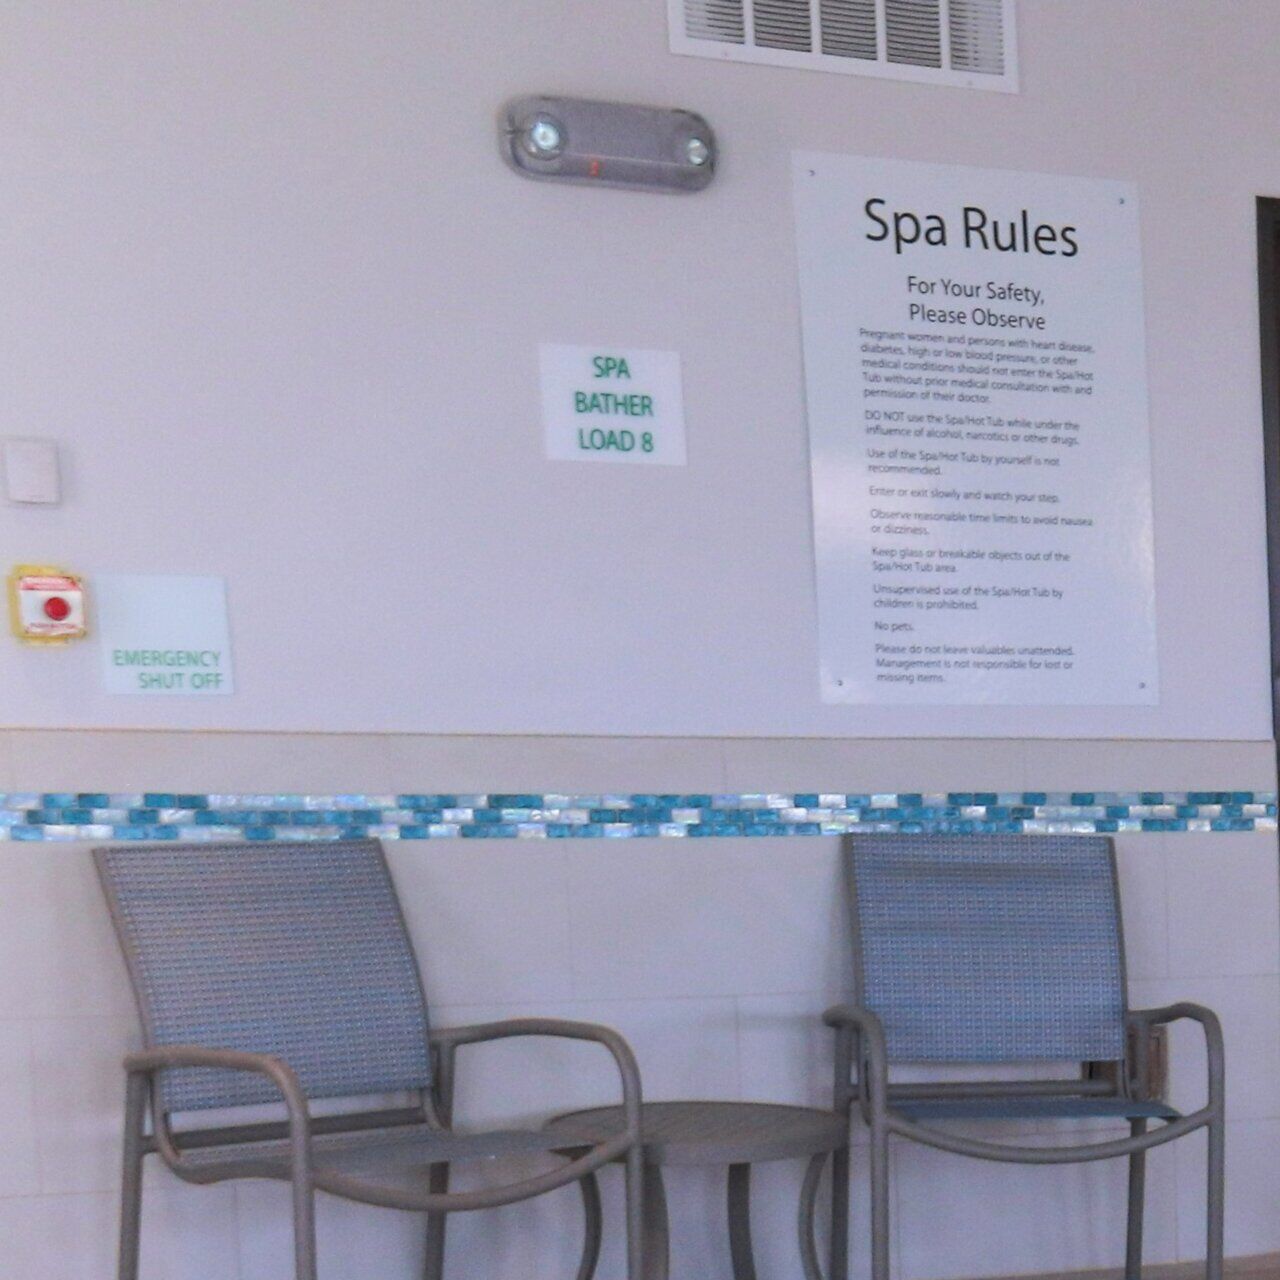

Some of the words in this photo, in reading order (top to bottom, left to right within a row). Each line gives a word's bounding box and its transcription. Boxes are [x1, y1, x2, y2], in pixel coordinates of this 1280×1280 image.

[864, 197, 947, 255] Spa
[962, 206, 1079, 257] Rules
[907, 275, 937, 297] For
[940, 278, 982, 299] Your
[986, 281, 1045, 306] Safety,
[909, 303, 967, 326] Please
[971, 307, 1047, 331] Observe
[859, 328, 904, 341] Pregnant
[908, 335, 944, 343] women
[947, 336, 965, 344] and
[968, 337, 1005, 348] persons
[1008, 338, 1028, 348] with
[908, 346, 930, 358] high
[945, 348, 962, 358] low
[966, 350, 993, 361] blood
[1053, 355, 1077, 365] other
[593, 356, 631, 379] SPA
[862, 359, 899, 369] medical
[904, 360, 954, 372] conditions
[958, 363, 989, 374] should
[992, 367, 1008, 376] not
[1011, 368, 1035, 377] enter
[1039, 368, 1052, 378] the
[863, 373, 881, 382] Tub
[885, 374, 922, 385] without
[925, 376, 948, 387] prior
[951, 378, 988, 389] medical
[992, 380, 1049, 392] consultation
[1052, 384, 1072, 393] with
[1075, 386, 1092, 394] and
[575, 391, 654, 417] BATHER
[864, 390, 916, 400] permission
[921, 391, 931, 399] of
[934, 391, 954, 401] their
[865, 411, 880, 420] DO
[884, 412, 904, 422] NOT
[907, 414, 924, 423] use
[927, 413, 942, 423] the
[987, 416, 1004, 427] Tub
[1007, 418, 1032, 427] while
[1035, 419, 1061, 429] under
[1064, 421, 1080, 430] the
[578, 428, 635, 451] LOAD
[642, 432, 654, 452] 8
[866, 425, 912, 436] influence
[915, 427, 925, 436] of
[1011, 434, 1021, 442] or
[1024, 433, 1048, 443] other
[867, 449, 885, 458] Use
[889, 449, 898, 459] of
[901, 450, 916, 460] the
[961, 453, 978, 462] Tub
[981, 454, 991, 465] by
[995, 455, 1032, 465] yourself
[1044, 457, 1060, 466] not
[869, 486, 895, 496] Enter
[898, 488, 907, 496] or
[911, 488, 928, 497] exit
[931, 488, 960, 500] slowly
[963, 490, 981, 499] and
[984, 491, 1013, 501] watch
[1015, 493, 1035, 502] your
[871, 509, 911, 520] Observe
[914, 511, 966, 522] reasonable
[969, 513, 990, 523] time
[1021, 515, 1031, 524] to
[1034, 515, 1058, 525] avoid
[872, 547, 897, 558] Keep
[989, 550, 1022, 562] objects
[1025, 553, 1040, 561] out
[1043, 551, 1052, 561] of
[1055, 551, 1070, 562] the
[916, 562, 933, 572] Tub
[874, 584, 940, 596] Unsupervised
[943, 586, 960, 595] use
[962, 586, 972, 595] of
[974, 586, 989, 596] the
[1033, 587, 1049, 597] Tub
[1052, 588, 1063, 600] by
[874, 599, 914, 608] children
[875, 621, 889, 631] No
[875, 643, 907, 654] Please
[910, 644, 922, 654] do
[925, 645, 940, 654] not
[114, 650, 221, 667] EMERGENCY
[876, 659, 941, 670] Management
[953, 660, 970, 669] not
[973, 659, 1026, 670] responsible
[1029, 660, 1042, 669] for
[1045, 660, 1061, 670] lost
[1063, 662, 1073, 670] or
[139, 672, 185, 689] SHUT
[190, 673, 224, 689] OFF
[877, 673, 914, 683] missing
